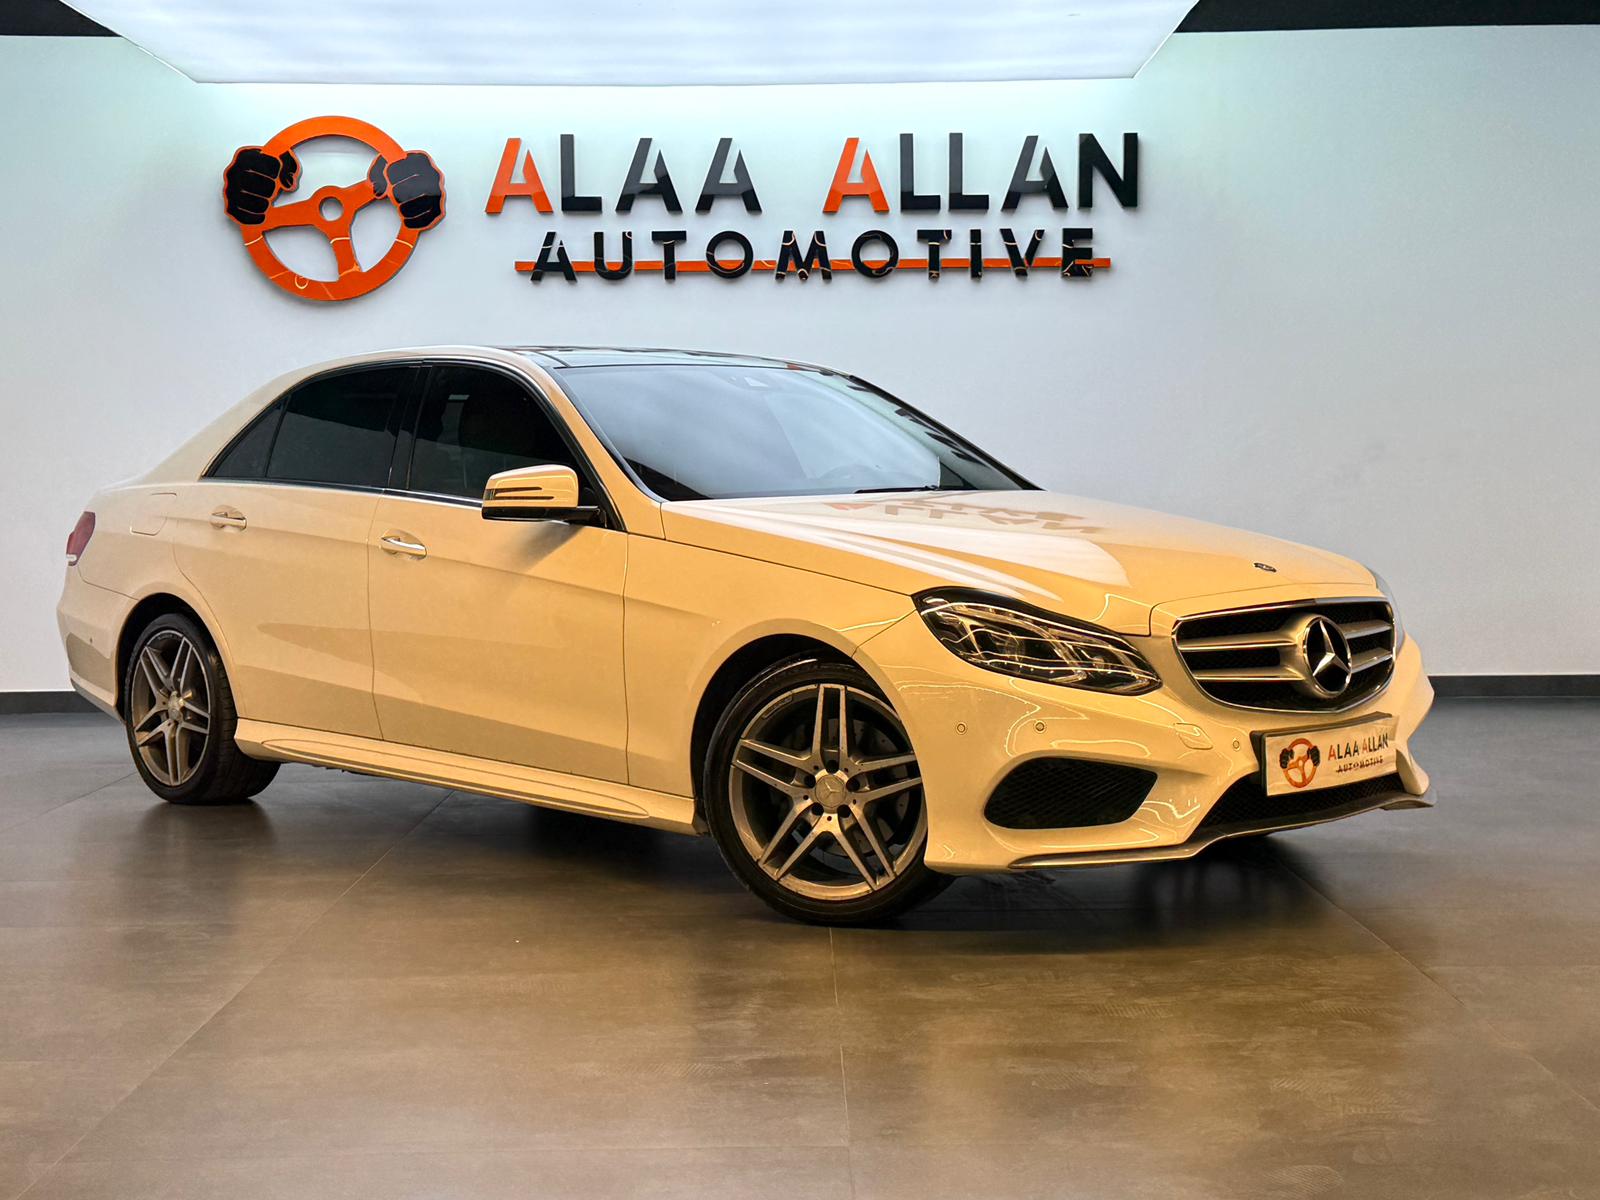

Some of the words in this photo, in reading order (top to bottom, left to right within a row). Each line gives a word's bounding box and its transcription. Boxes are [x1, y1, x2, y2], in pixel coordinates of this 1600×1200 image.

[485, 133, 764, 214] ALAA
[821, 132, 1139, 214] ALLAN
[529, 228, 1096, 283] AUTOMOTIVE
[1328, 740, 1360, 761] ALAA
[1362, 733, 1389, 752] ALLAN
